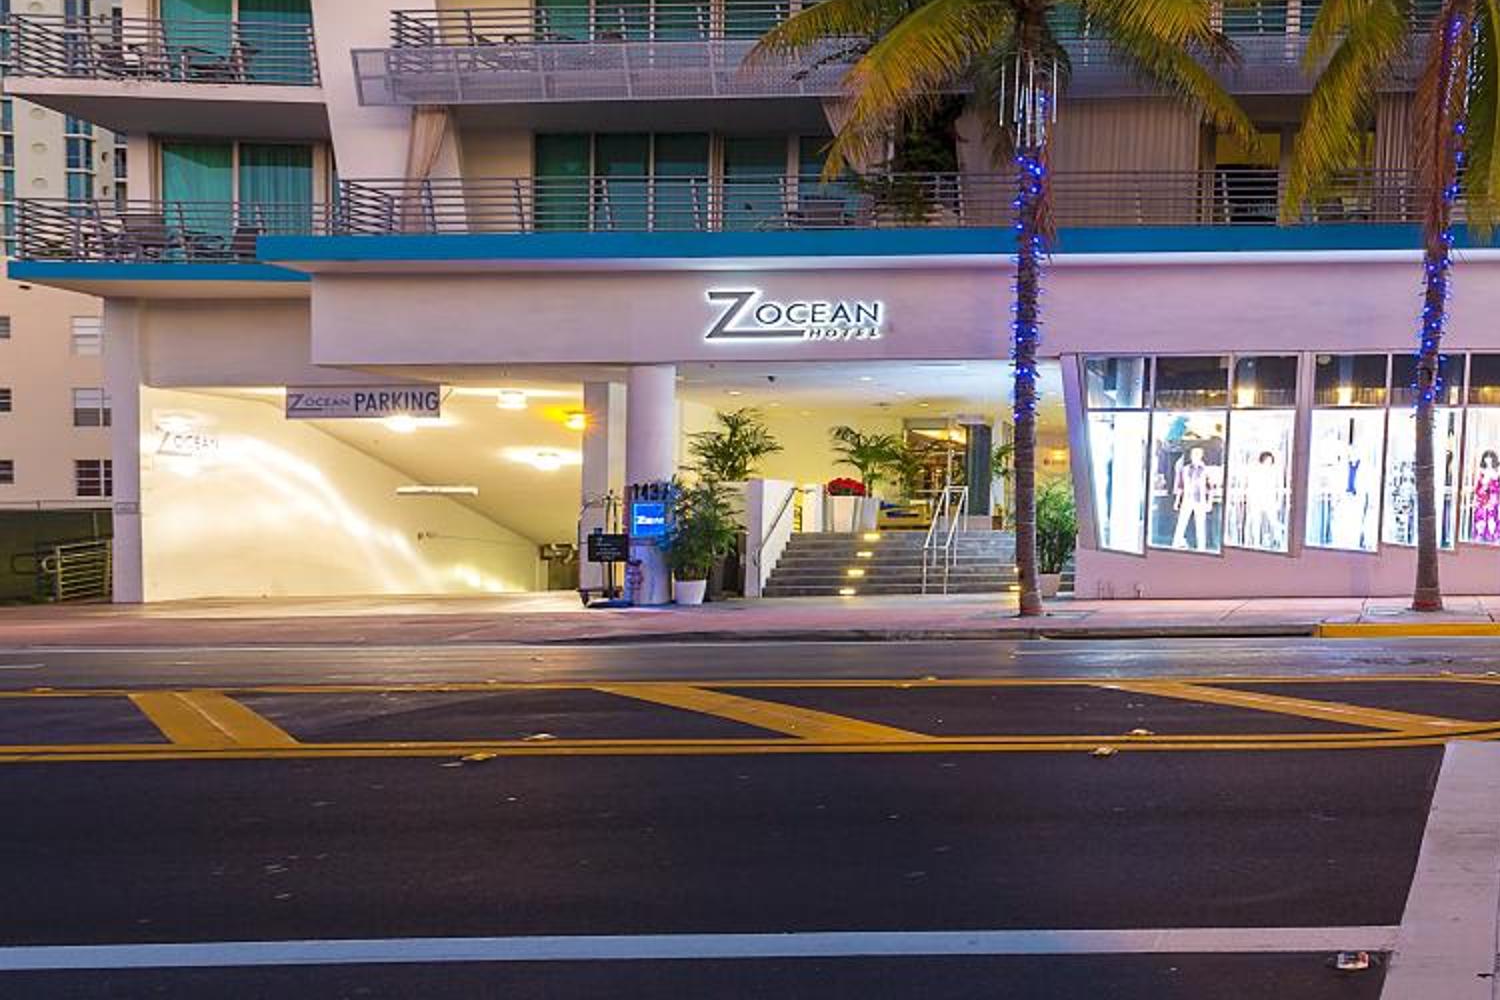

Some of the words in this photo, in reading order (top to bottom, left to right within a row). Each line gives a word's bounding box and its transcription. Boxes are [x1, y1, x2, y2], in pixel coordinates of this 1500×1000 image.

[755, 302, 880, 325] OCEAN
[808, 328, 880, 340] HOTEL
[354, 391, 440, 412] PARKING
